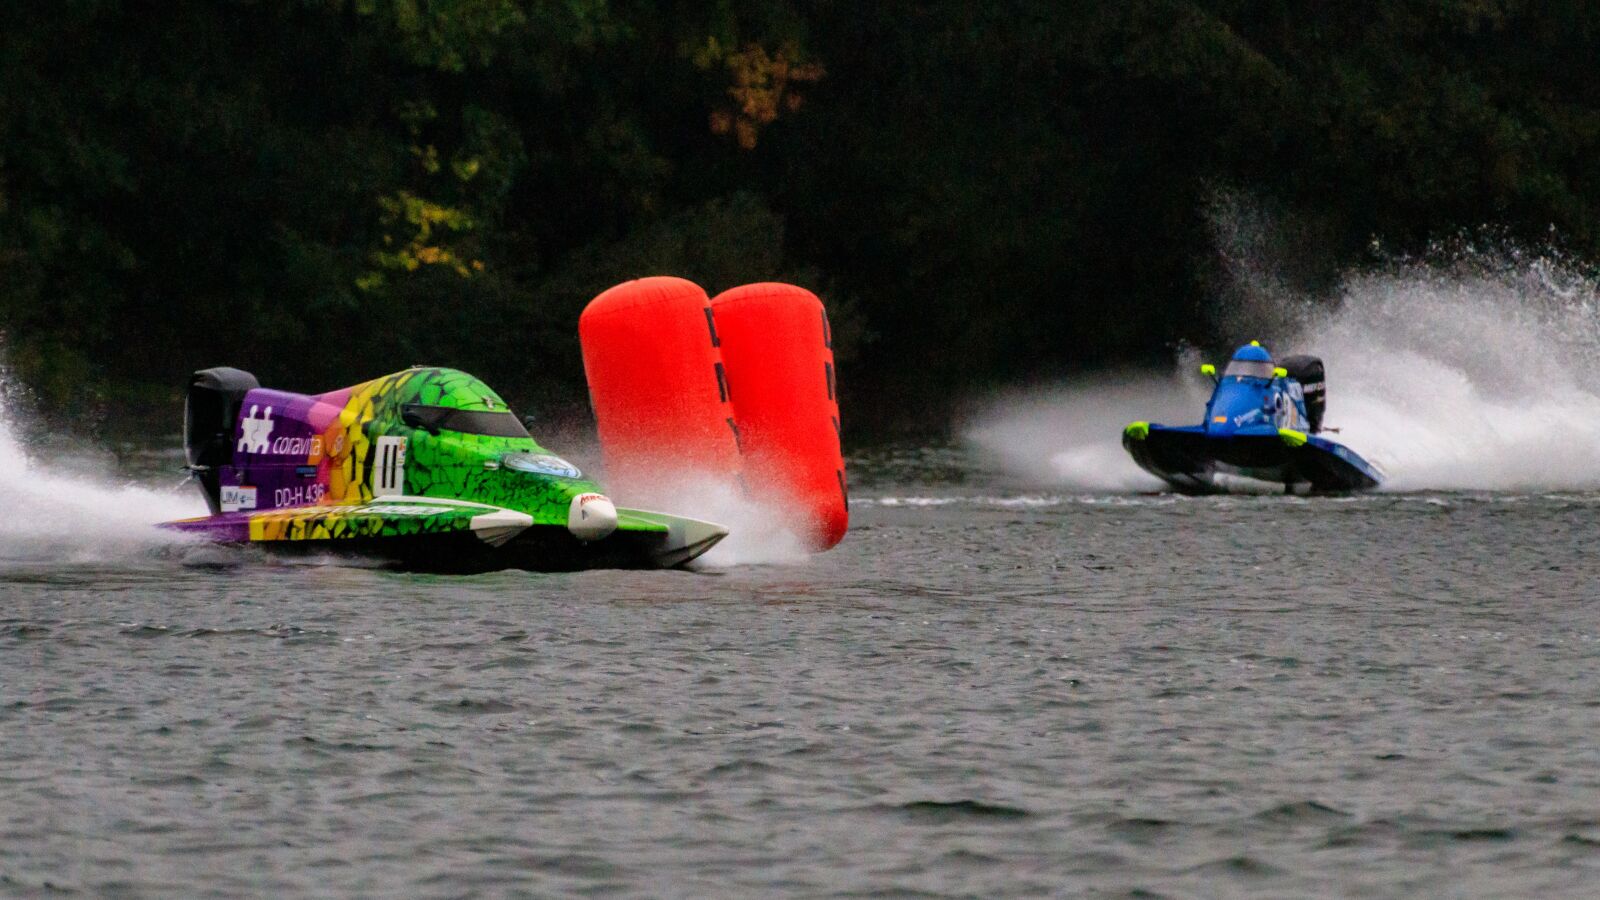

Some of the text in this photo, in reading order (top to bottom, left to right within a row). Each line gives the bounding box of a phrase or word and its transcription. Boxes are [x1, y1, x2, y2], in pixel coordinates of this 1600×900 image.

[272, 432, 321, 456] coravita
[275, 486, 303, 507] DD-H
[305, 483, 325, 503] 436
